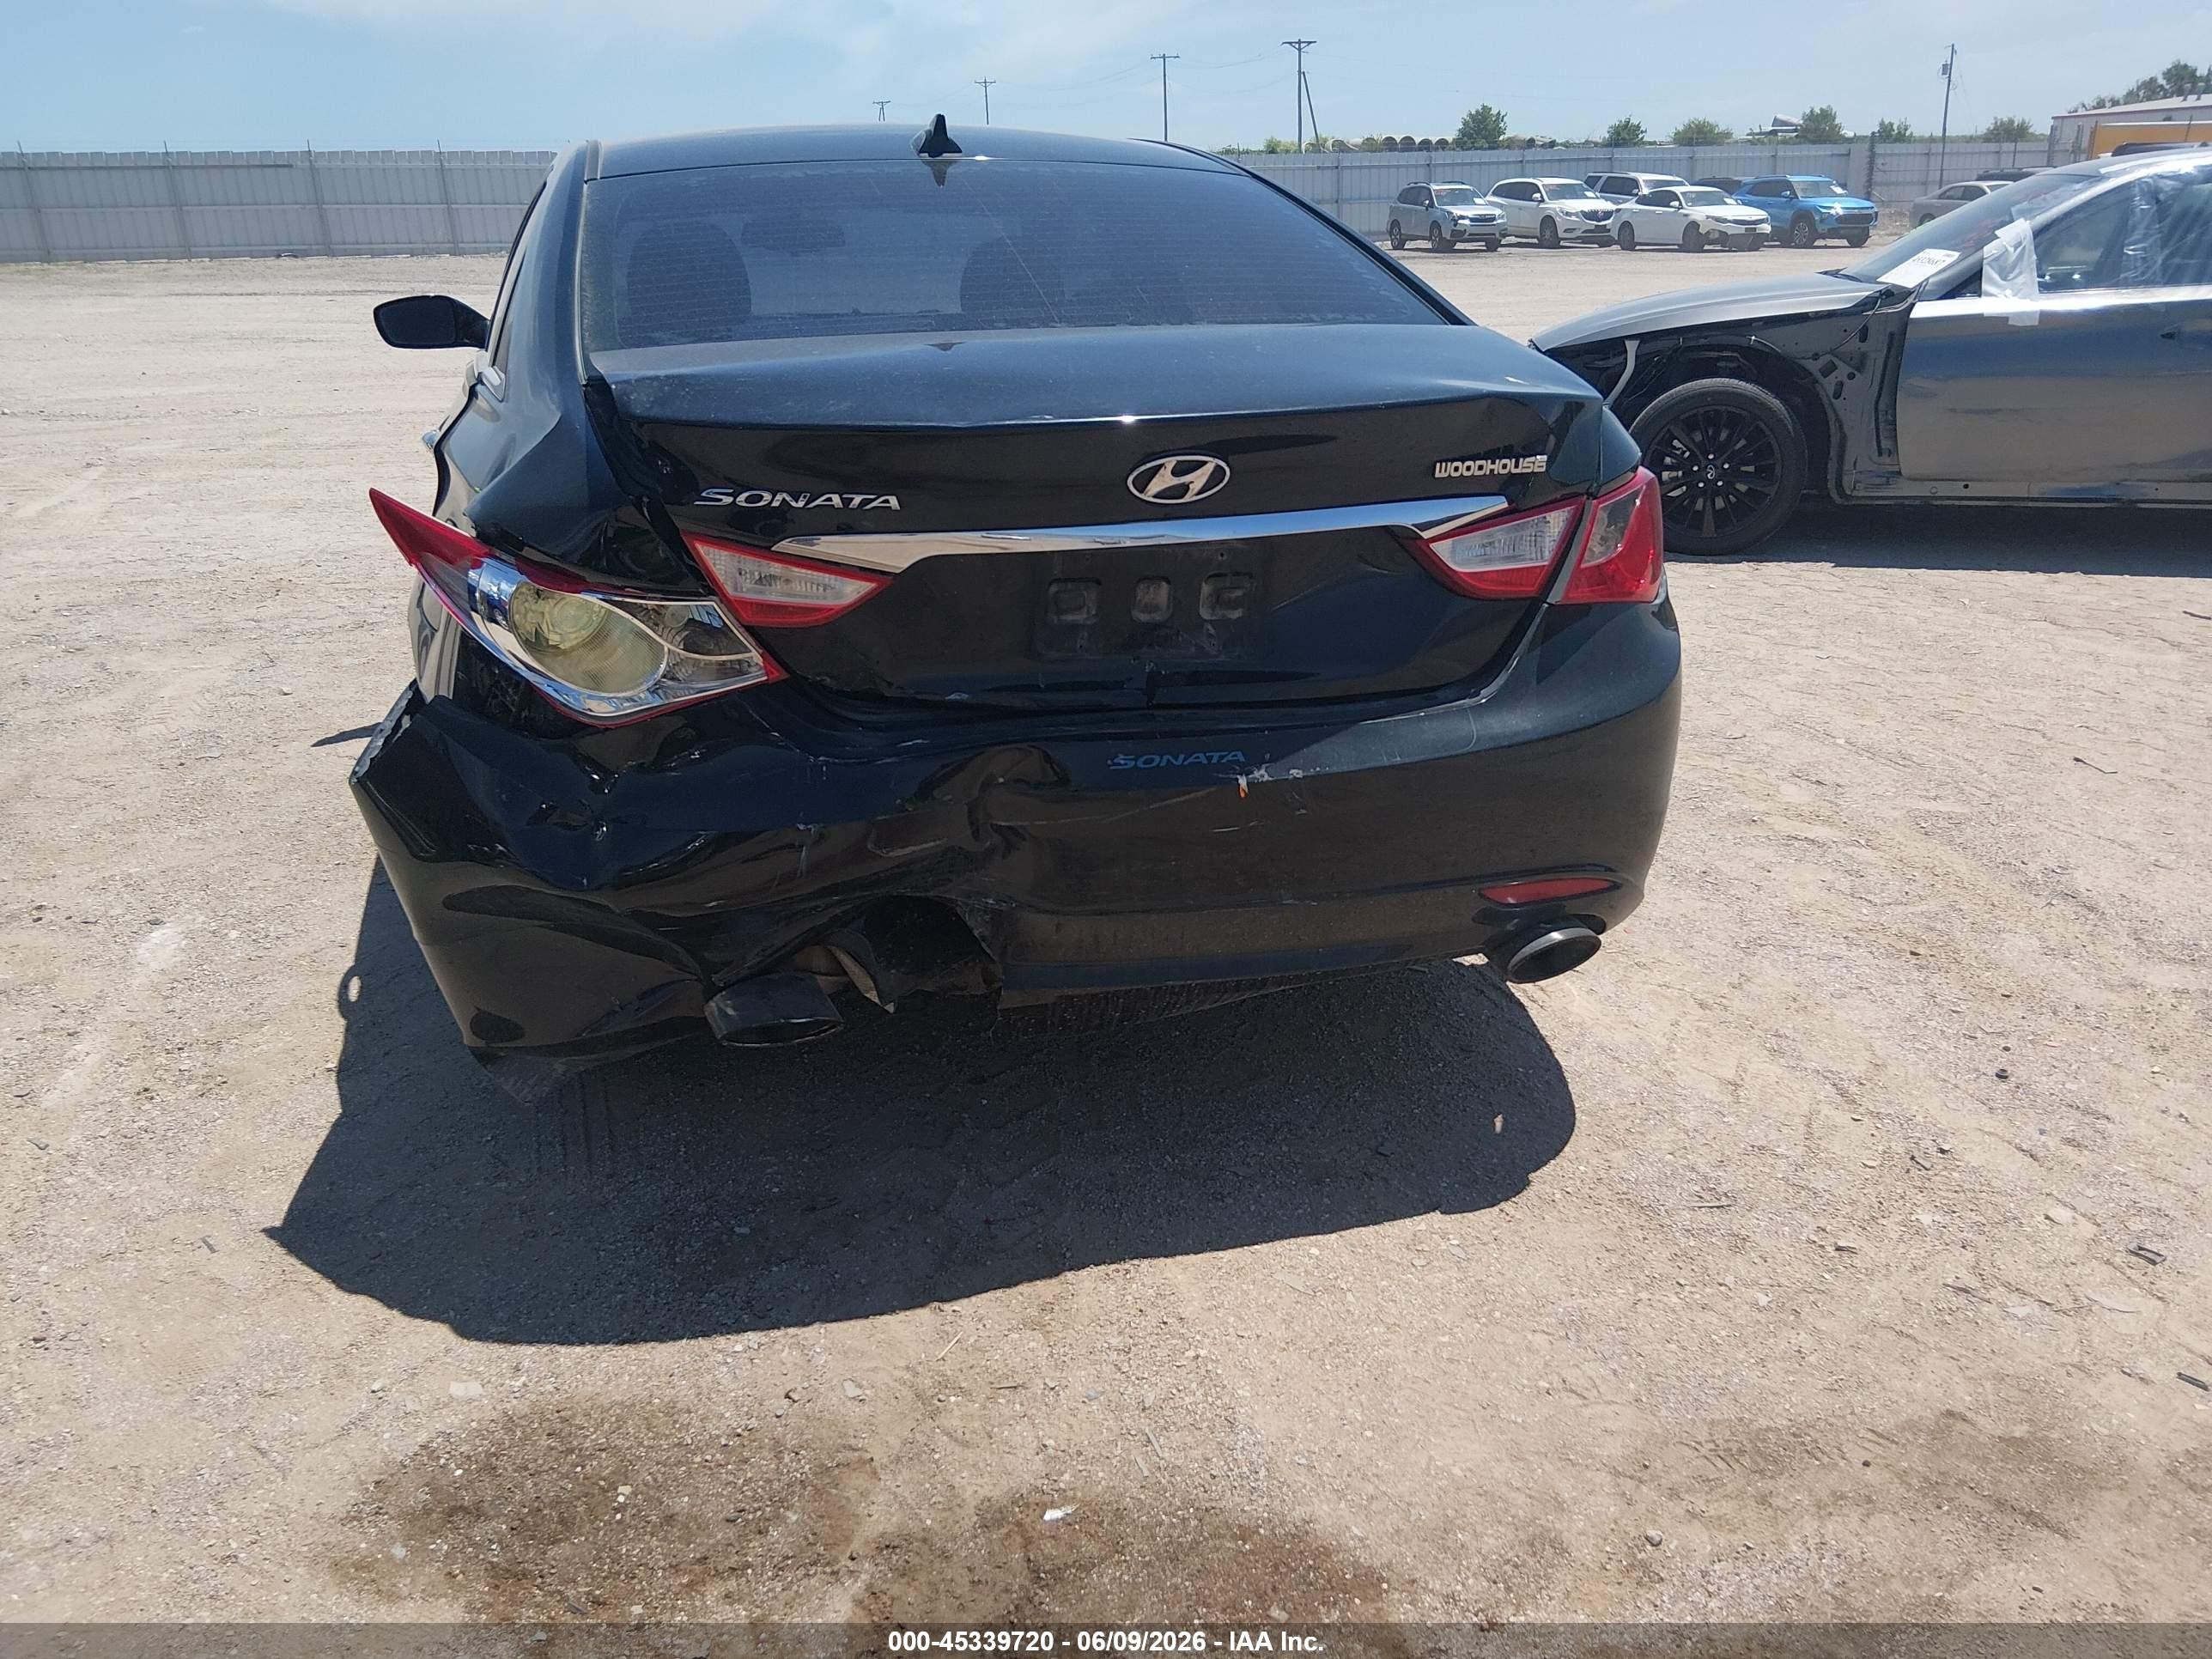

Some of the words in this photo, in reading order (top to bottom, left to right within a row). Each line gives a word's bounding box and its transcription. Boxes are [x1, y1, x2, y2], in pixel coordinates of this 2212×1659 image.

[1434, 454, 1548, 478] WOODHOUSE
[694, 488, 902, 511] SONATA
[1108, 750, 1246, 770] SONATA
